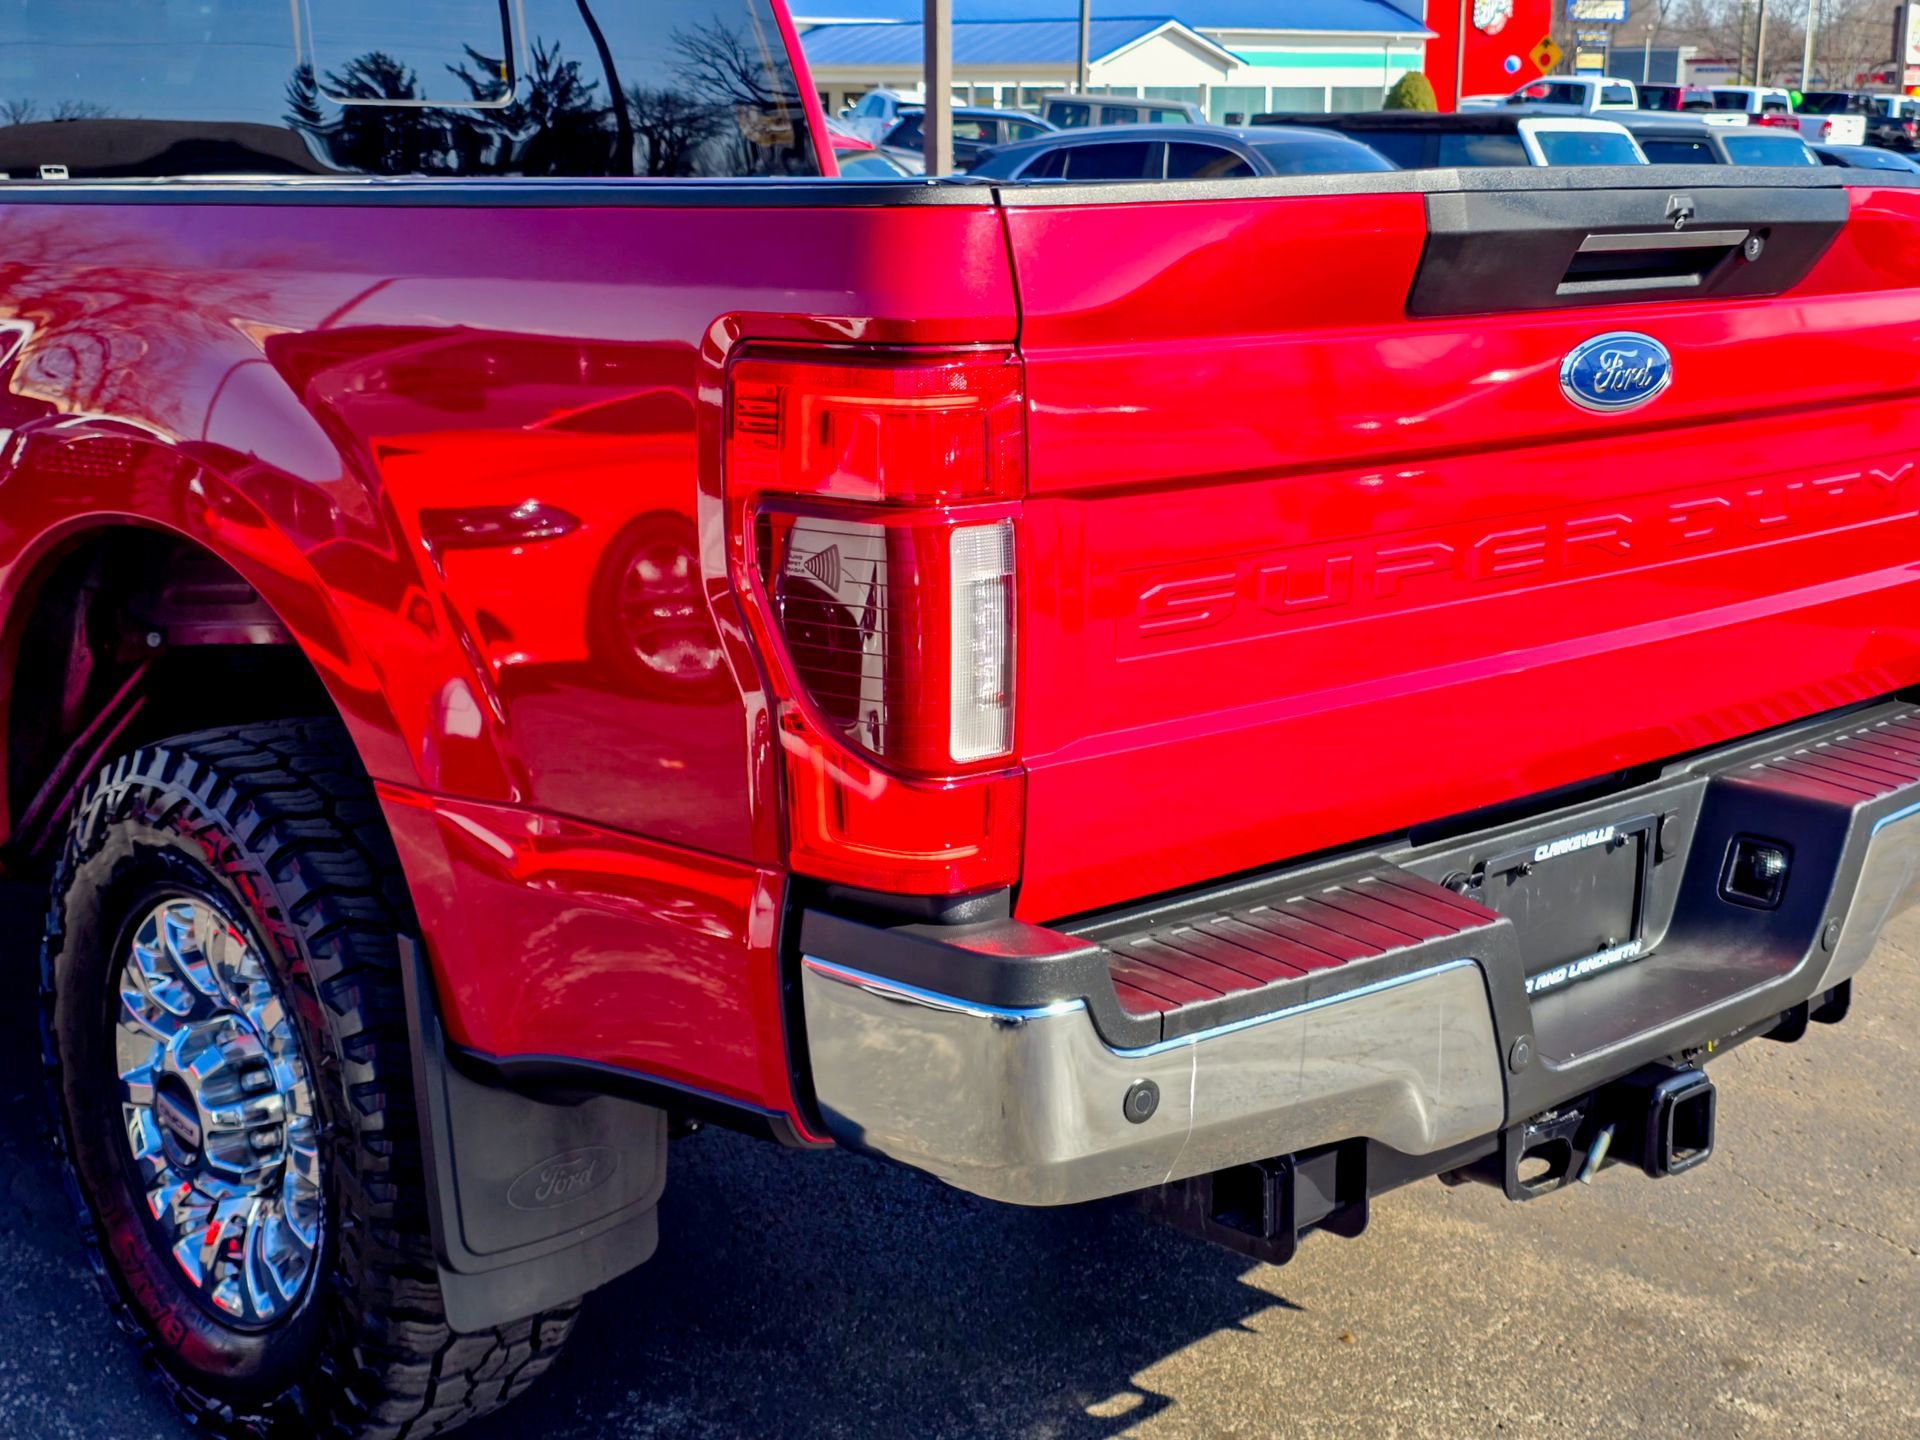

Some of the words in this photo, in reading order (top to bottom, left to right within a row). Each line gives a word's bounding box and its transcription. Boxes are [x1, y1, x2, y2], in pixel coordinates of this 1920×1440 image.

[1594, 349, 1653, 393] Ford
[1138, 512, 1633, 639] SUPER
[1666, 461, 1916, 547] DUTY
[1534, 967, 1567, 990] AND
[535, 1157, 597, 1201] Ford
